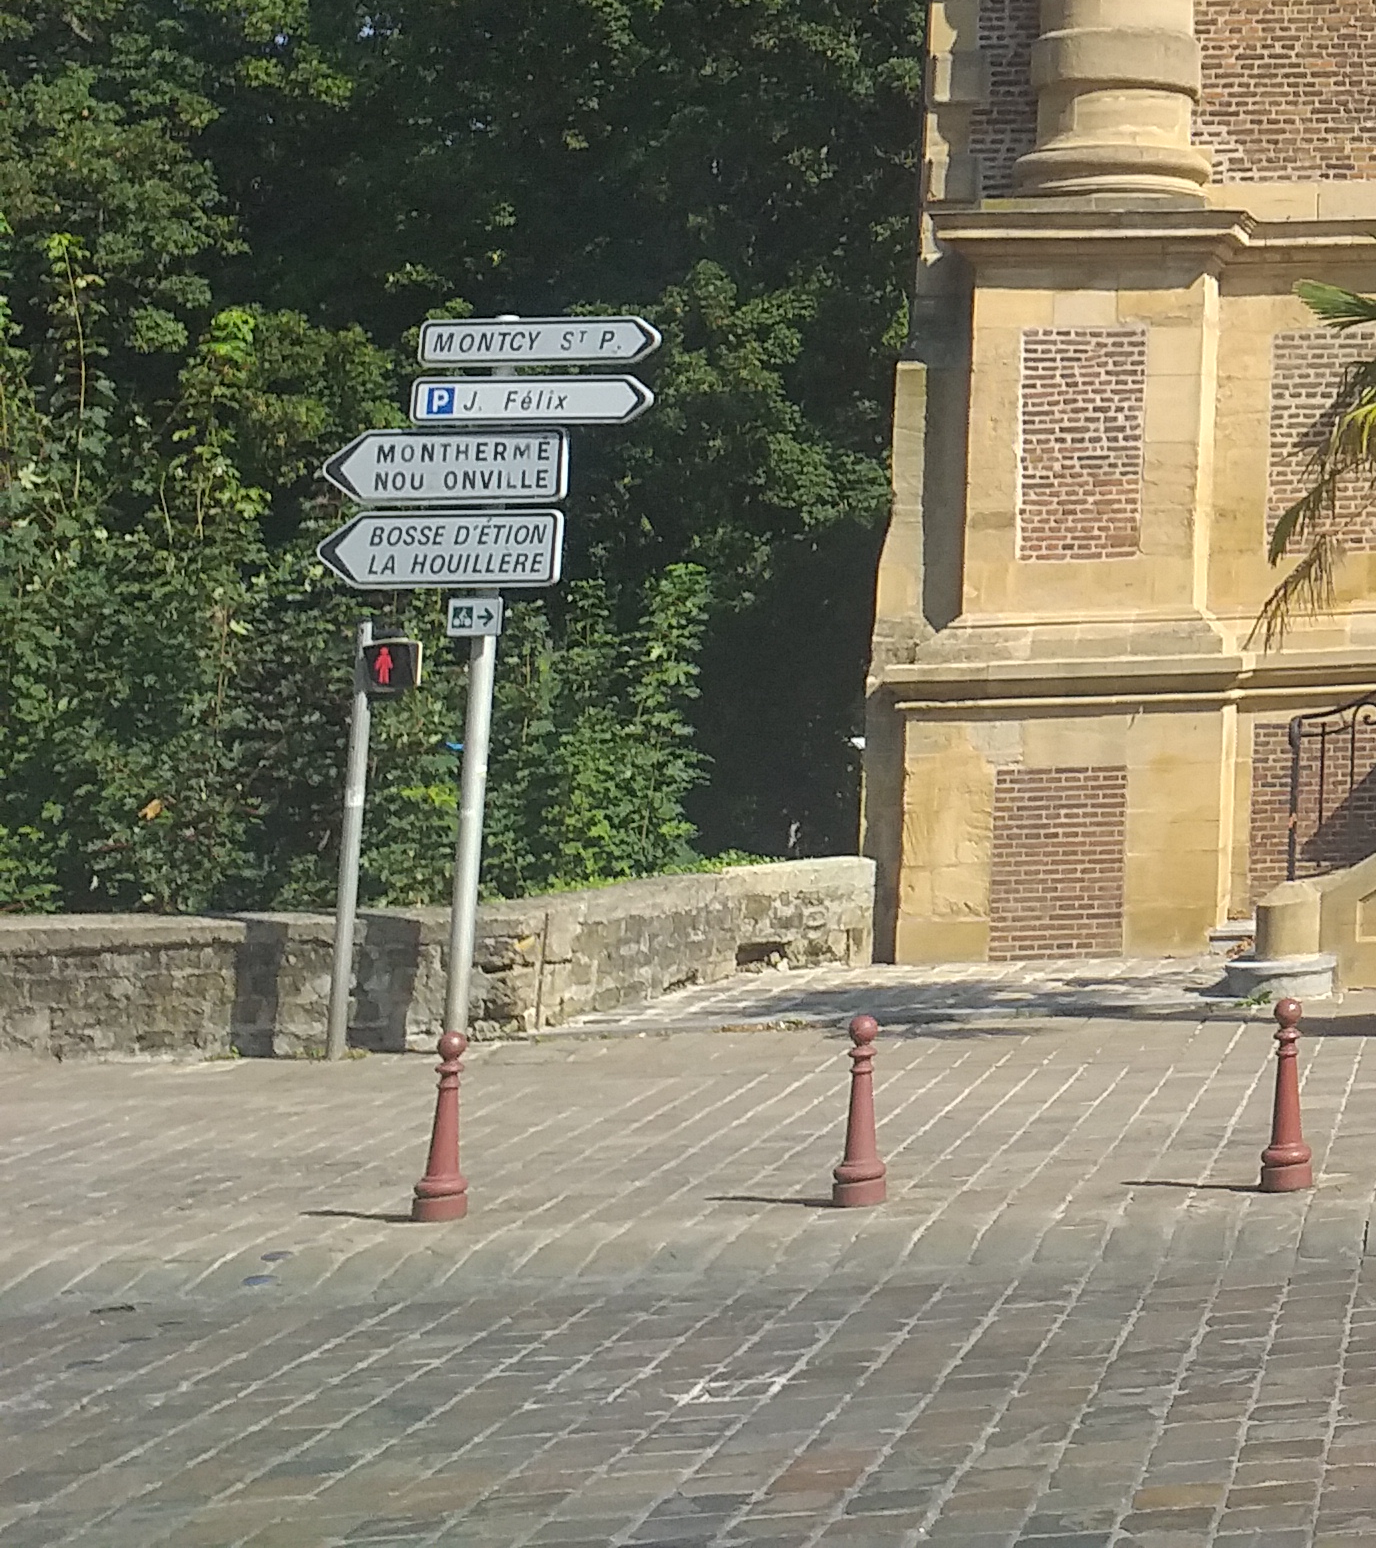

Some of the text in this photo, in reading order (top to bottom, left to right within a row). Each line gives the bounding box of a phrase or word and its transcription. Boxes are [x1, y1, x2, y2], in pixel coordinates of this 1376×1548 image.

[433, 331, 541, 353] MONTCY
[599, 330, 622, 351] P.
[463, 390, 482, 412] J.
[504, 389, 568, 412] Félix
[376, 436, 551, 464] MONTHERMÉ
[369, 517, 547, 546] BOSSE D'ÉTION
[368, 546, 545, 575] LA HOUILLÈRE
